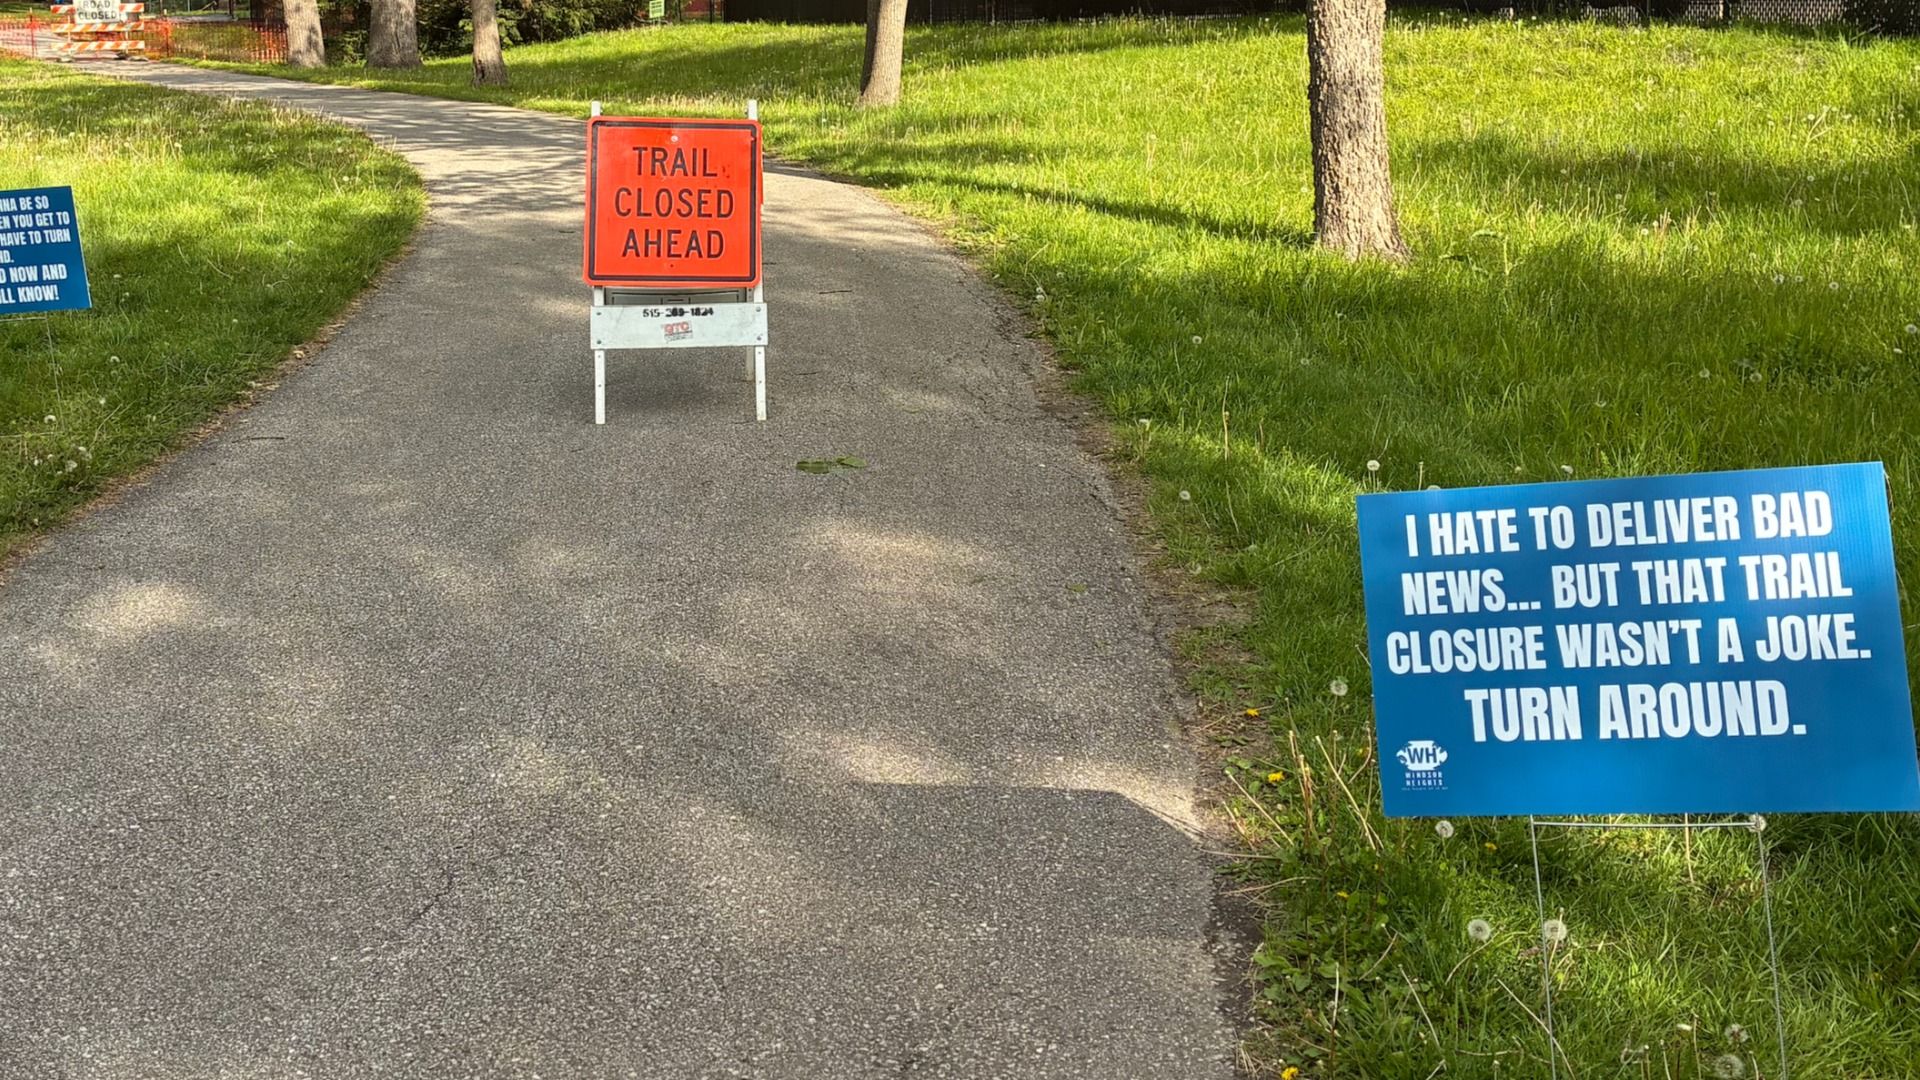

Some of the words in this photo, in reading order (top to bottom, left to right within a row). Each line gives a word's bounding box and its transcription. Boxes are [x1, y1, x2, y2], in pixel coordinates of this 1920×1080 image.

[82, 0, 111, 8] ROAD
[78, 10, 117, 20] CLOSED
[632, 147, 718, 177] TRAIL
[19, 196, 33, 211] BE
[34, 195, 49, 210] SO
[615, 187, 734, 218] CLOSED
[12, 213, 33, 228] YOU
[35, 212, 54, 227] GET
[55, 211, 70, 226] TO
[0, 231, 27, 246] HAVE
[27, 230, 42, 245] TO
[43, 228, 71, 244] TURN
[621, 229, 724, 258] AHEAD
[9, 265, 38, 283] NOW
[41, 263, 68, 281] AND
[17, 284, 60, 303] KNOW!
[1405, 514, 1419, 557] I
[1428, 508, 1520, 556] HATE
[1528, 505, 1575, 550] TO
[1586, 496, 1741, 548] DELIVER
[1751, 490, 1833, 539] BAD
[1401, 568, 1541, 616] NEWS...
[1551, 562, 1620, 609] BUT
[1632, 557, 1727, 605] THAT
[1738, 551, 1853, 601] TRAIL
[1386, 625, 1546, 675] CLOSURE
[1555, 619, 1702, 668] WASN'T
[1718, 617, 1744, 663] A
[1755, 613, 1872, 662] JOKE.
[1463, 685, 1582, 742] TURN
[1598, 680, 1807, 740] AROUND.
[1407, 747, 1438, 764] WH
